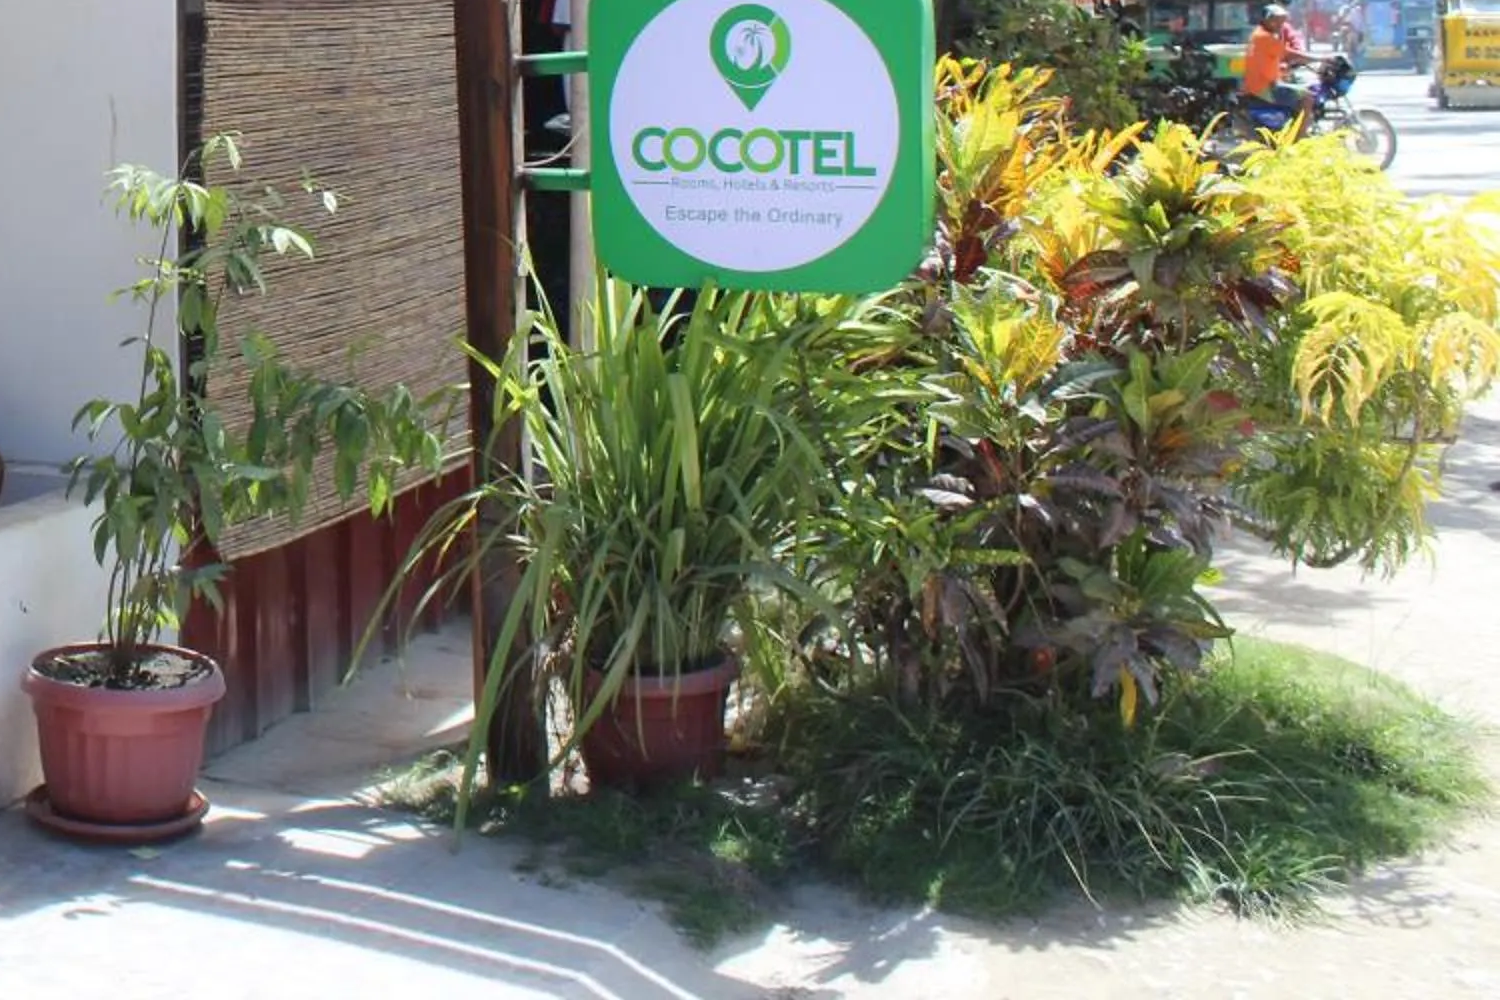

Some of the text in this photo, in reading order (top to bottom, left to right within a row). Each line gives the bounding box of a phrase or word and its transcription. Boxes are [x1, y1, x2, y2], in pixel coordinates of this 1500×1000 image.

[631, 127, 877, 177] COCOTEL
[724, 178, 767, 192] Hotels
[770, 180, 780, 191] &
[783, 180, 836, 193] Resorts
[665, 206, 843, 228] Escape the Ordinary
